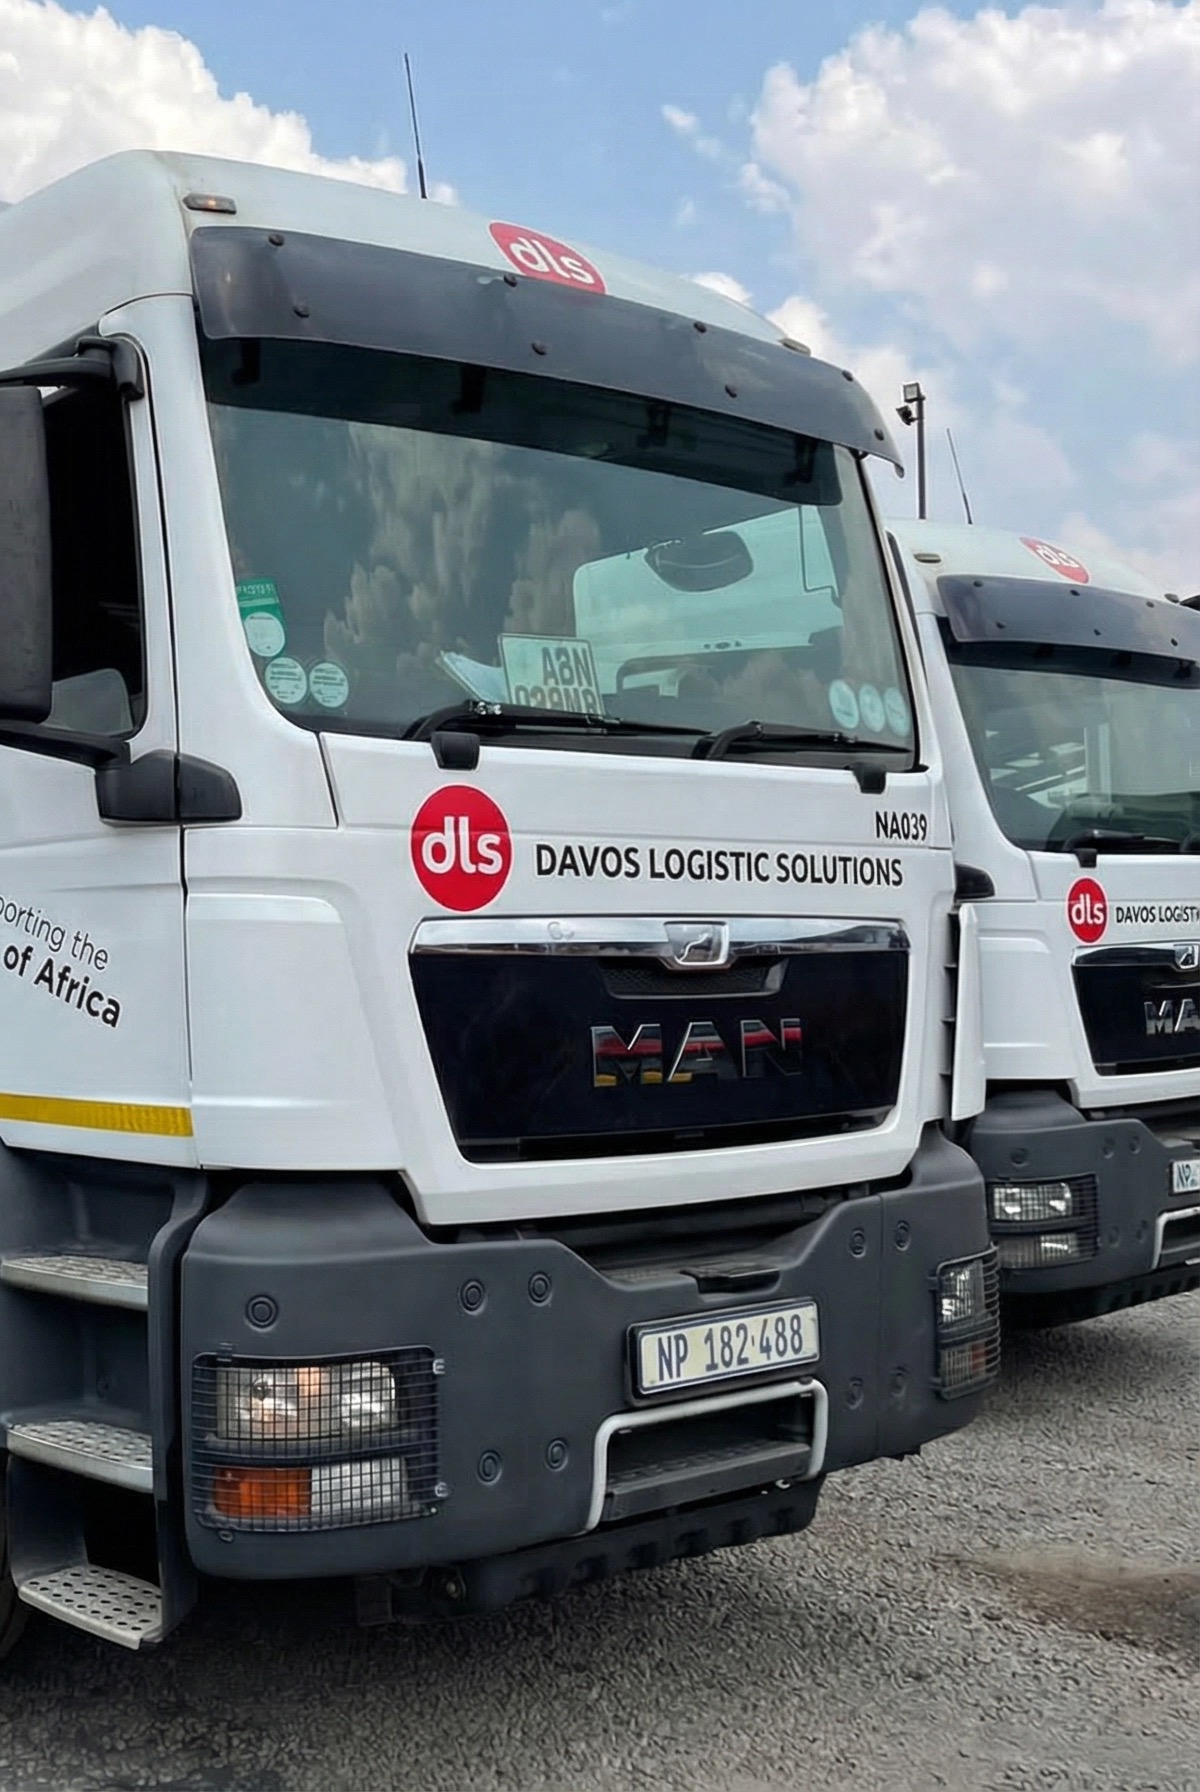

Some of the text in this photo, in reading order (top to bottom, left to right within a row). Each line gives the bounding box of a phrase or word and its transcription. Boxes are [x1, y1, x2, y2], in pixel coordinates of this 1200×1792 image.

[510, 236, 595, 284] dls
[875, 811, 928, 841] NA039
[421, 815, 903, 887] dls DAVOS LOGISTIC SOLUTIONS
[1071, 893, 1104, 925] dls
[1116, 905, 1156, 923] DAVOS
[72, 930, 109, 971] the
[3, 943, 34, 977] of
[34, 957, 122, 1028] Africa
[590, 1018, 802, 1087] MAN
[658, 1333, 688, 1382] NP
